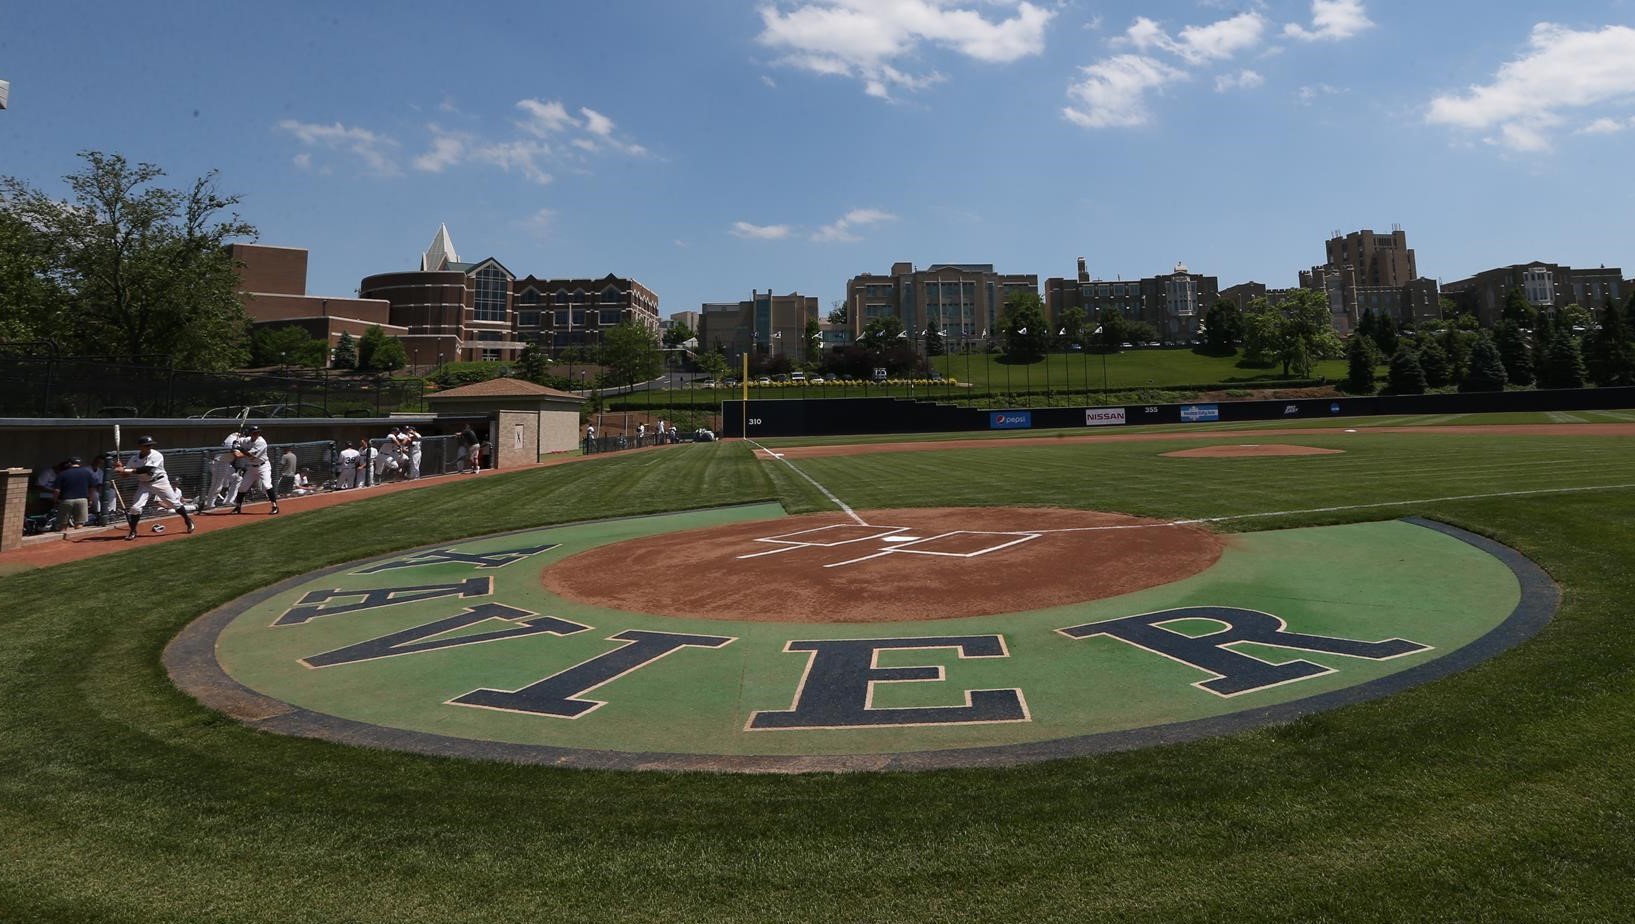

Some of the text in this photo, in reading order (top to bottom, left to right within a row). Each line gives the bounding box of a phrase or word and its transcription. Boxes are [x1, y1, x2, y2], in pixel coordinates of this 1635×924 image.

[1006, 416, 1026, 424] pepsi
[1087, 413, 1125, 421] NISSAN
[269, 543, 1435, 731] XAVIER
